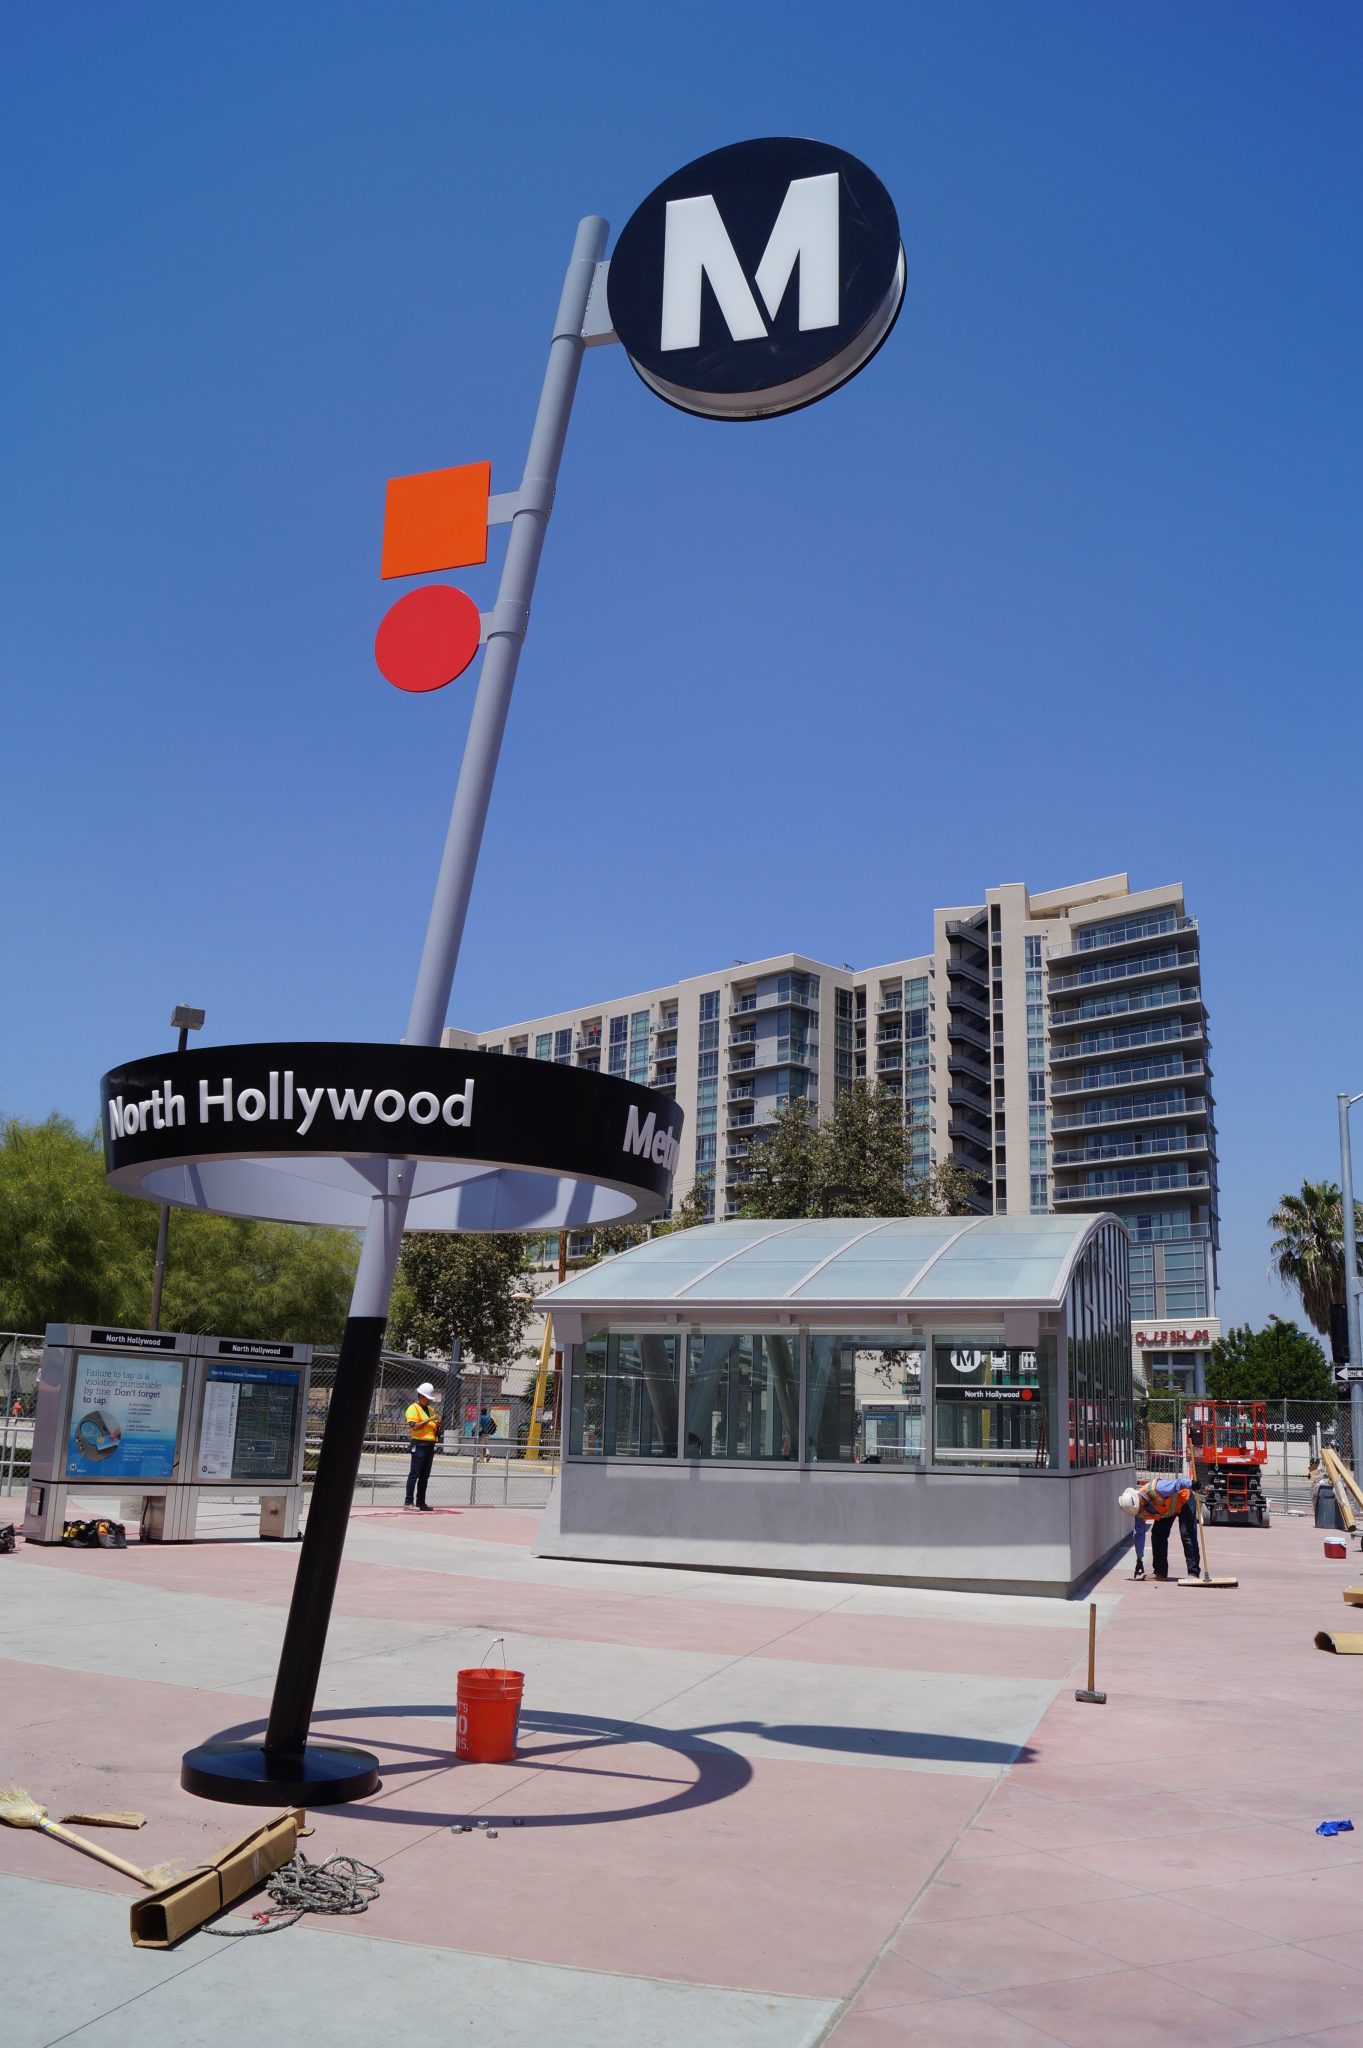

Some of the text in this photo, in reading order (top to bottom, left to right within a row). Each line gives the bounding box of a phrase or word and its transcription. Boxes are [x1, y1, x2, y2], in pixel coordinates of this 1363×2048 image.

[660, 172, 839, 351] M
[108, 1070, 475, 1141] North Hollywood
[106, 1334, 161, 1346] North Hollywood
[1135, 1329, 1209, 1343] GOLF SHOPS
[232, 1344, 281, 1355] North Hollywood
[956, 1350, 975, 1366] M
[86, 1368, 112, 1378] Failure
[113, 1370, 121, 1378] to
[123, 1371, 135, 1380] tap
[85, 1377, 161, 1389] violation punishable
[84, 1387, 94, 1396] by
[114, 1388, 136, 1396] Don't
[138, 1389, 161, 1399] forget
[964, 1390, 1020, 1399] North Hollywood
[83, 1396, 108, 1405] to tap.
